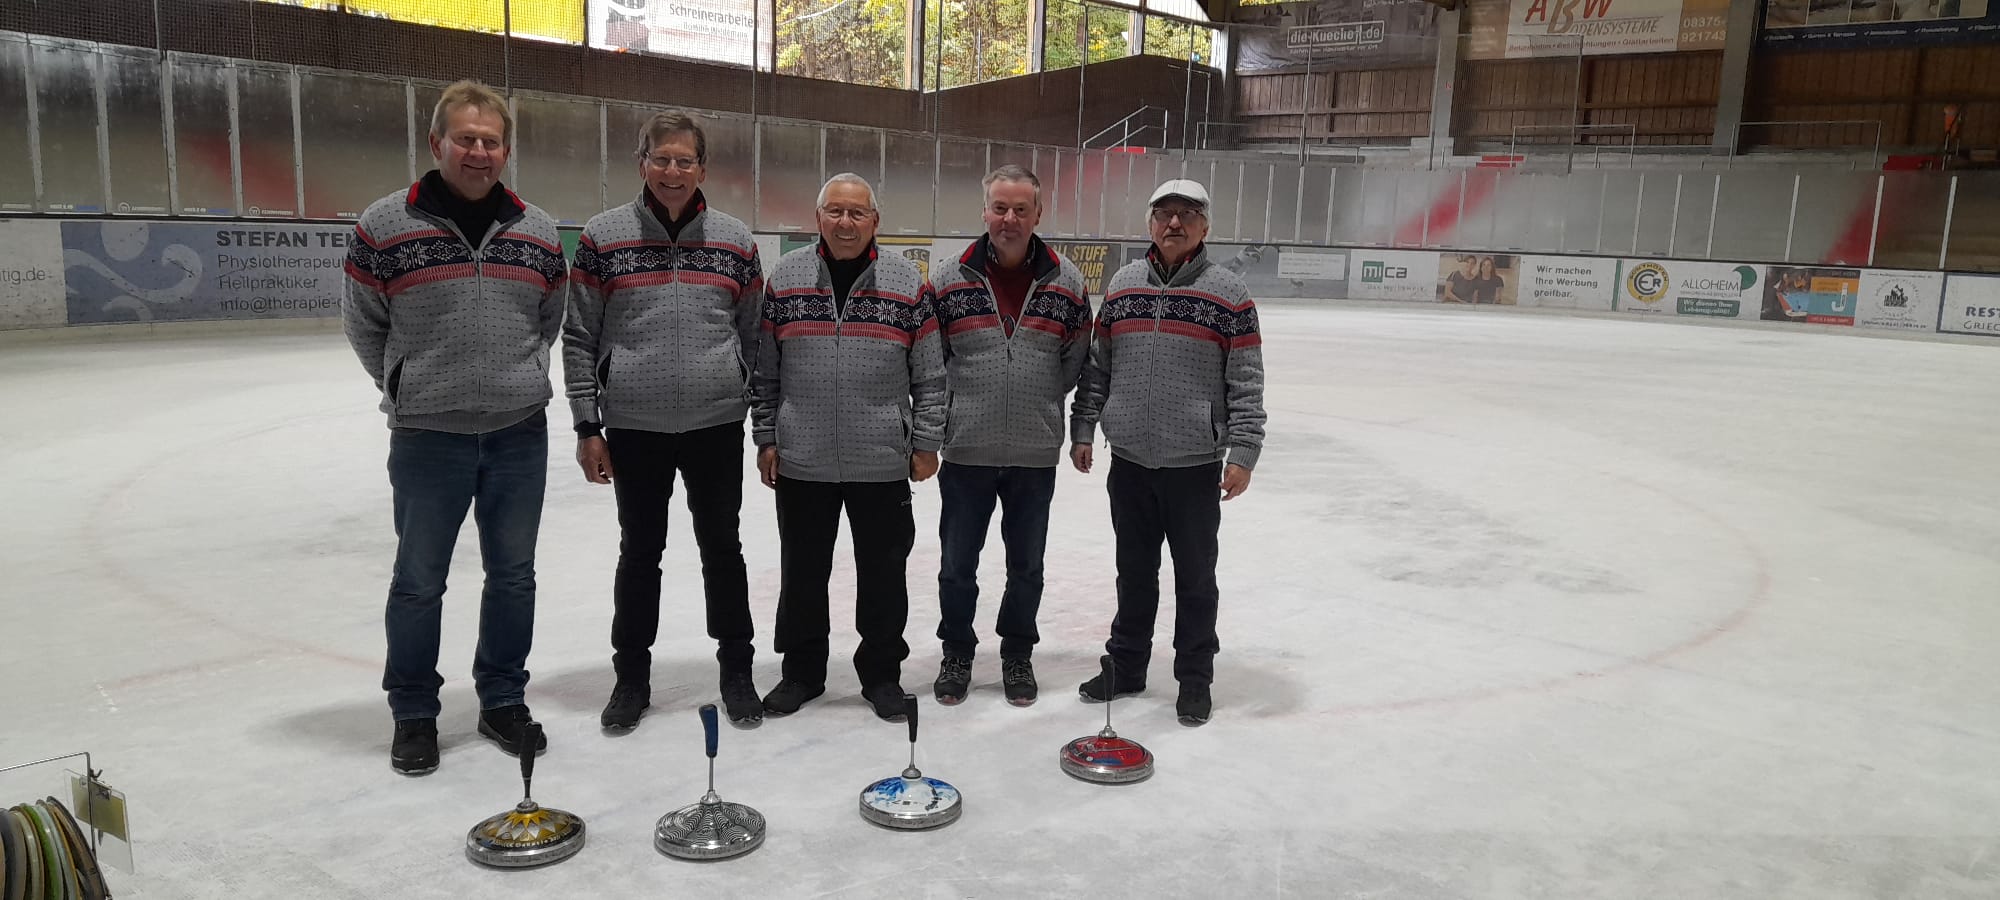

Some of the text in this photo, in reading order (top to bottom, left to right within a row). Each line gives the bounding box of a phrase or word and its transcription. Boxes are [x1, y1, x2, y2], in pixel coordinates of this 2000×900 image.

[669, 3, 759, 29] Schreinerarbeite
[216, 230, 308, 248] STEFAN
[1071, 245, 1109, 262] STUFF
[1536, 265, 1592, 275] Wir machen
[218, 275, 319, 291] Heilpraktiker
[1535, 277, 1598, 289] Ihre Werbung
[1681, 278, 1739, 291] ALLOHEIM
[1534, 289, 1573, 298] greifbar.
